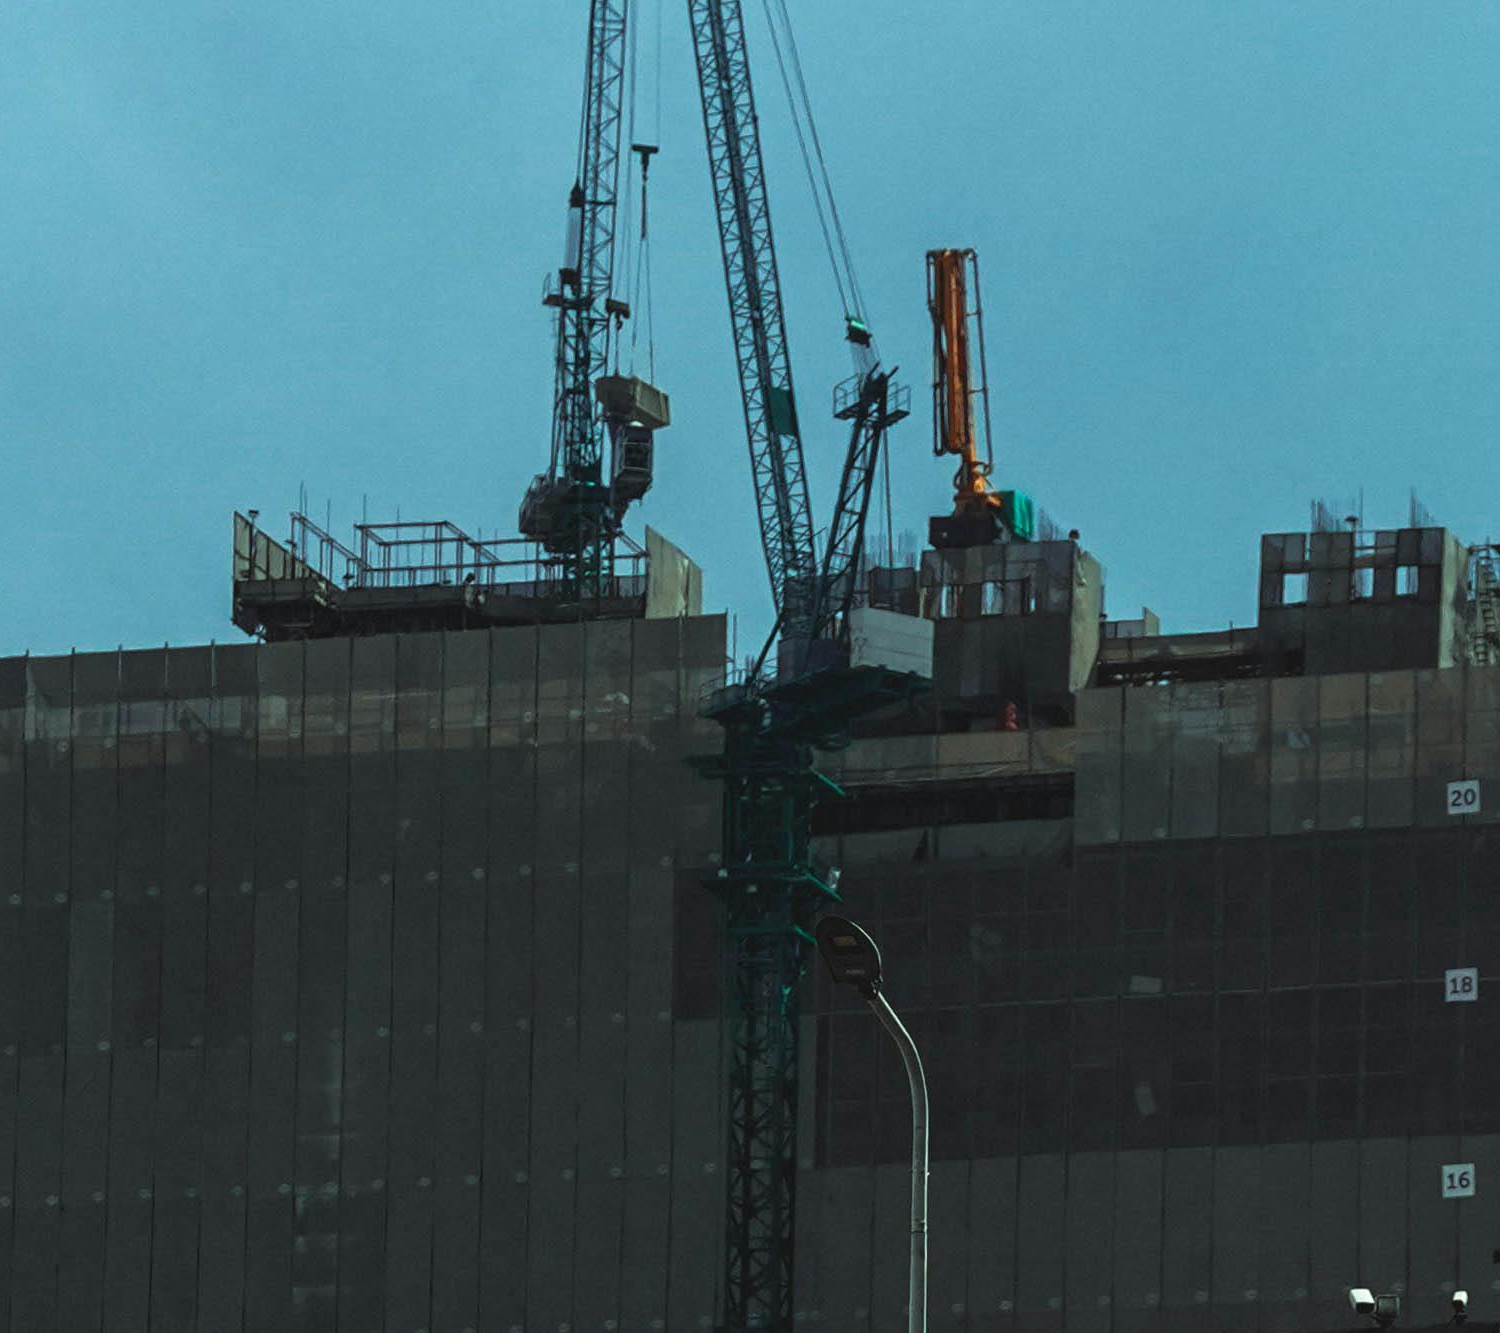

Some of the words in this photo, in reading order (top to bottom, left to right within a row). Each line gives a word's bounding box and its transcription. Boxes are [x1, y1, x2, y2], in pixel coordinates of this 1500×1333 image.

[1449, 786, 1477, 808] 20
[1449, 975, 1474, 996] 18
[1446, 1171, 1471, 1190] 16
